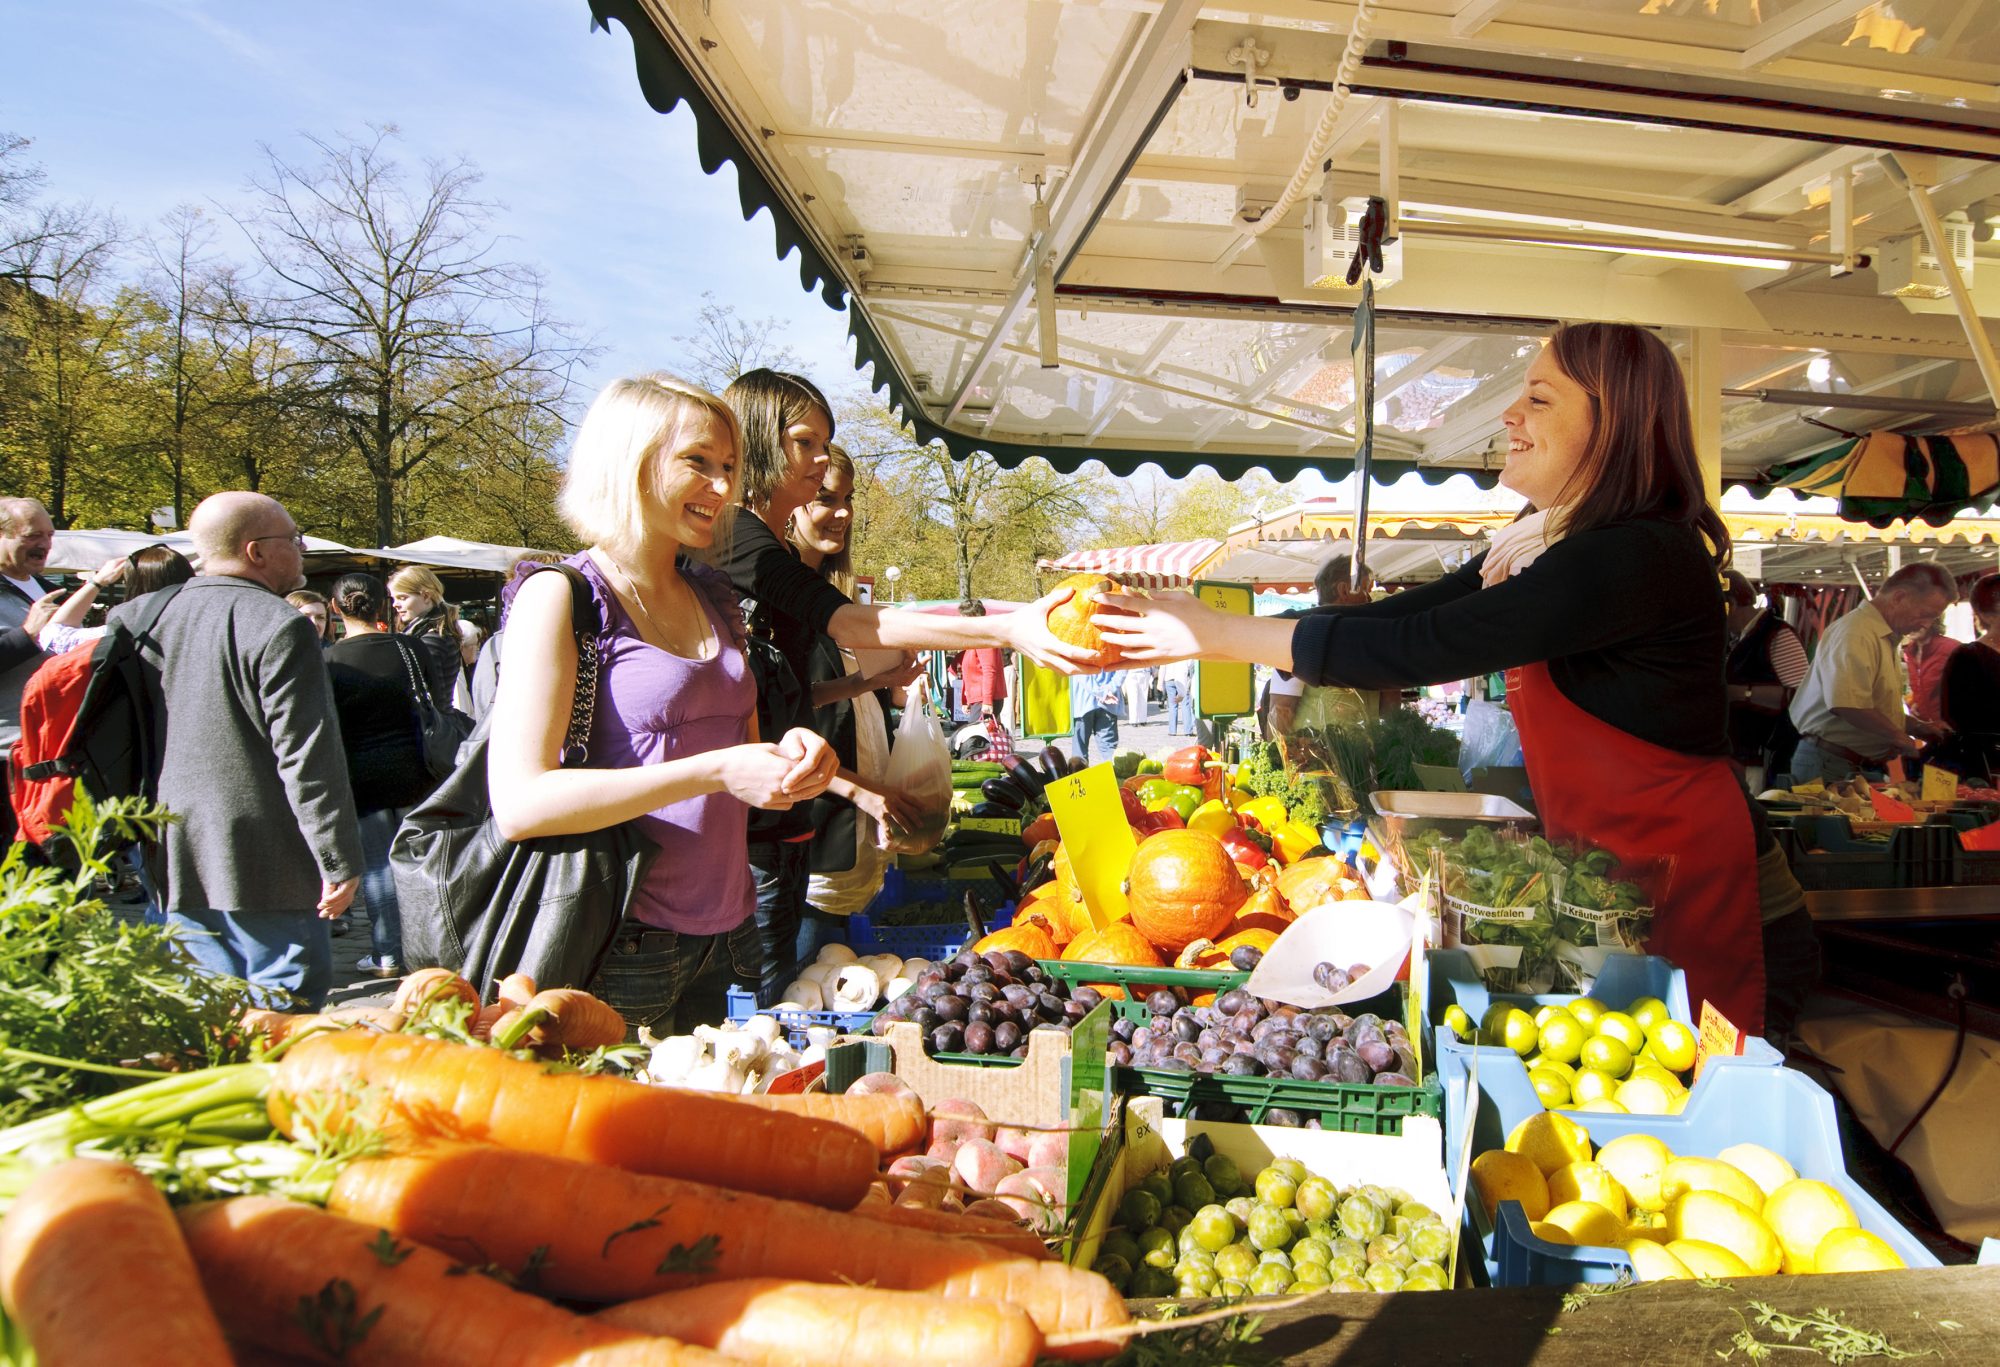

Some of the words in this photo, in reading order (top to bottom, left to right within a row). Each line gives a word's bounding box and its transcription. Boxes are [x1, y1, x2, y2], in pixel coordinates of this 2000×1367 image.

[1451, 900, 1462, 910] aus
[1463, 904, 1525, 918] Ostwestfalen
[1568, 906, 1602, 921] Kräuter
